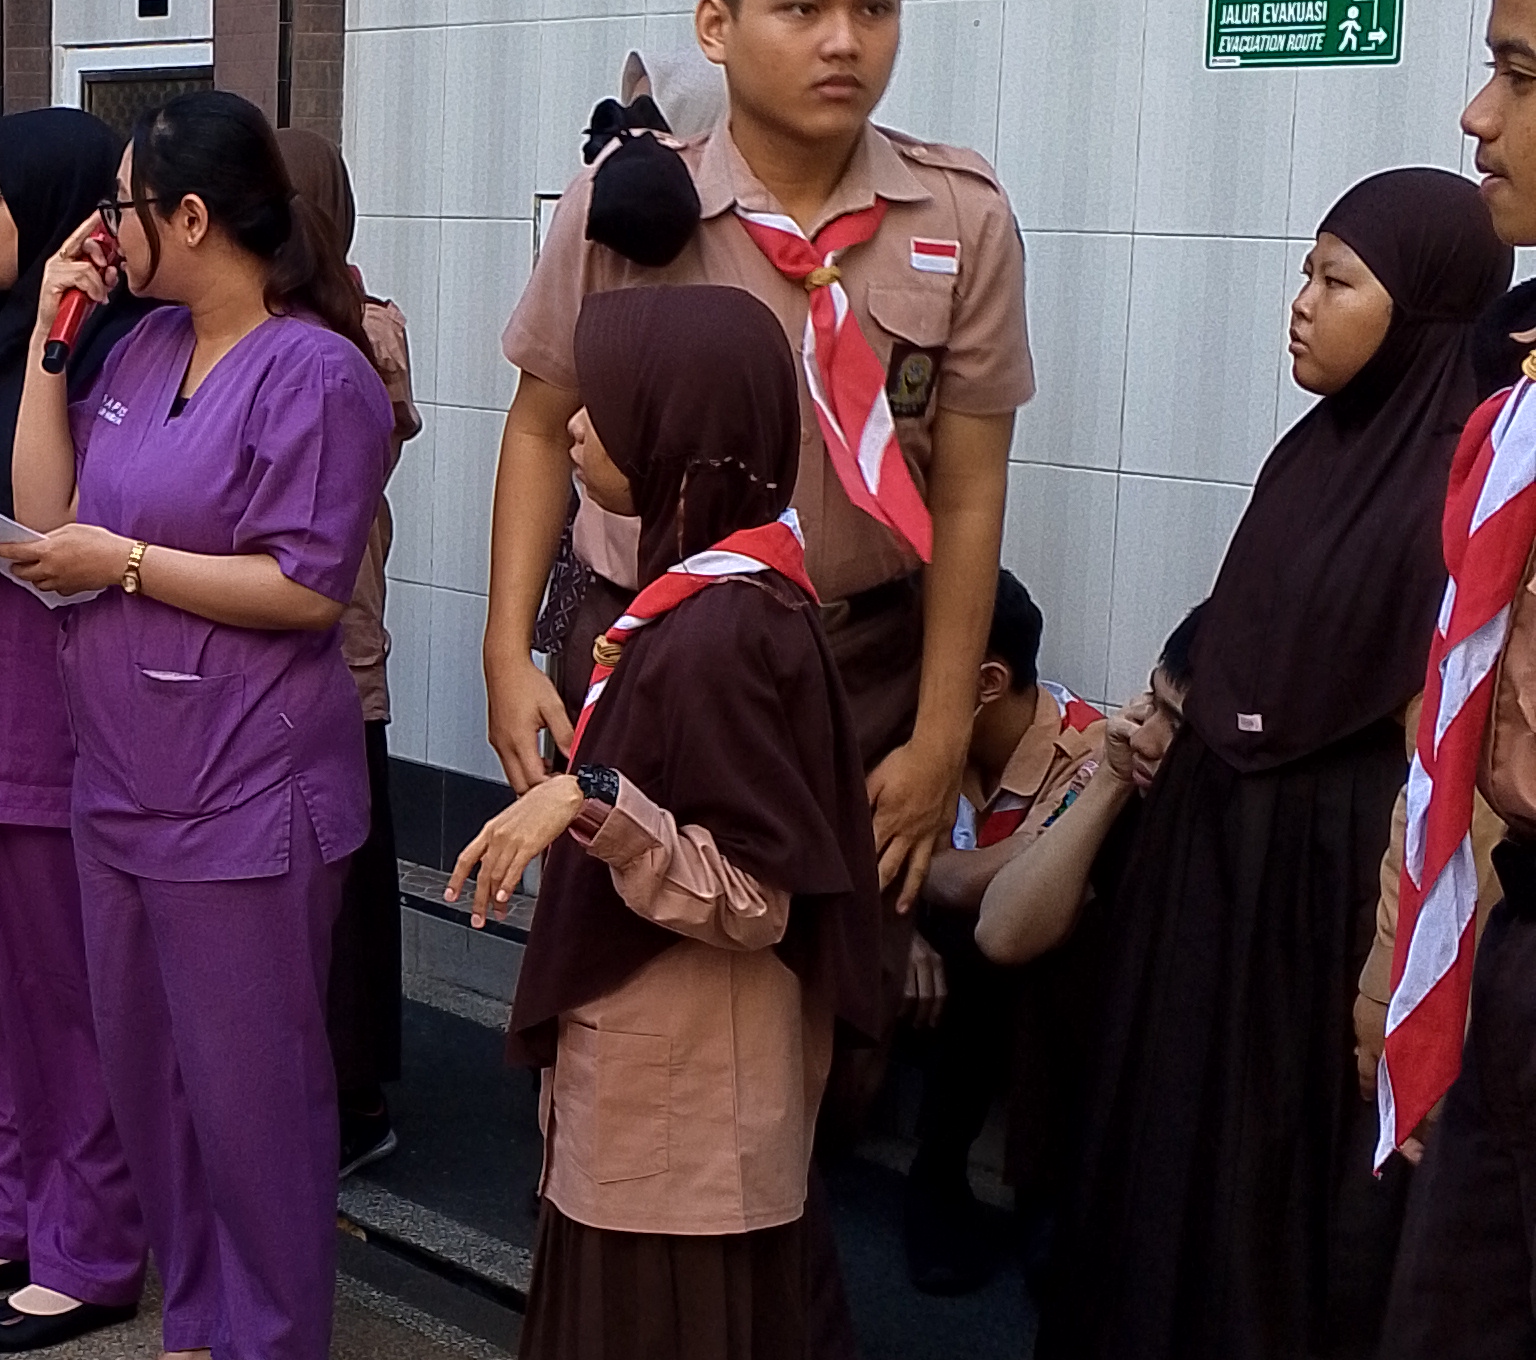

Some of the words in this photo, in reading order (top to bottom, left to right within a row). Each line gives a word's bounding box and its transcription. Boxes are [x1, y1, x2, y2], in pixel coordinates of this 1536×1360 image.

[1219, 3, 1260, 26] JALUR
[1262, 0, 1328, 24] EVAKUASI
[1218, 34, 1285, 53] EVACUATION
[1286, 32, 1326, 51] ROUTE
